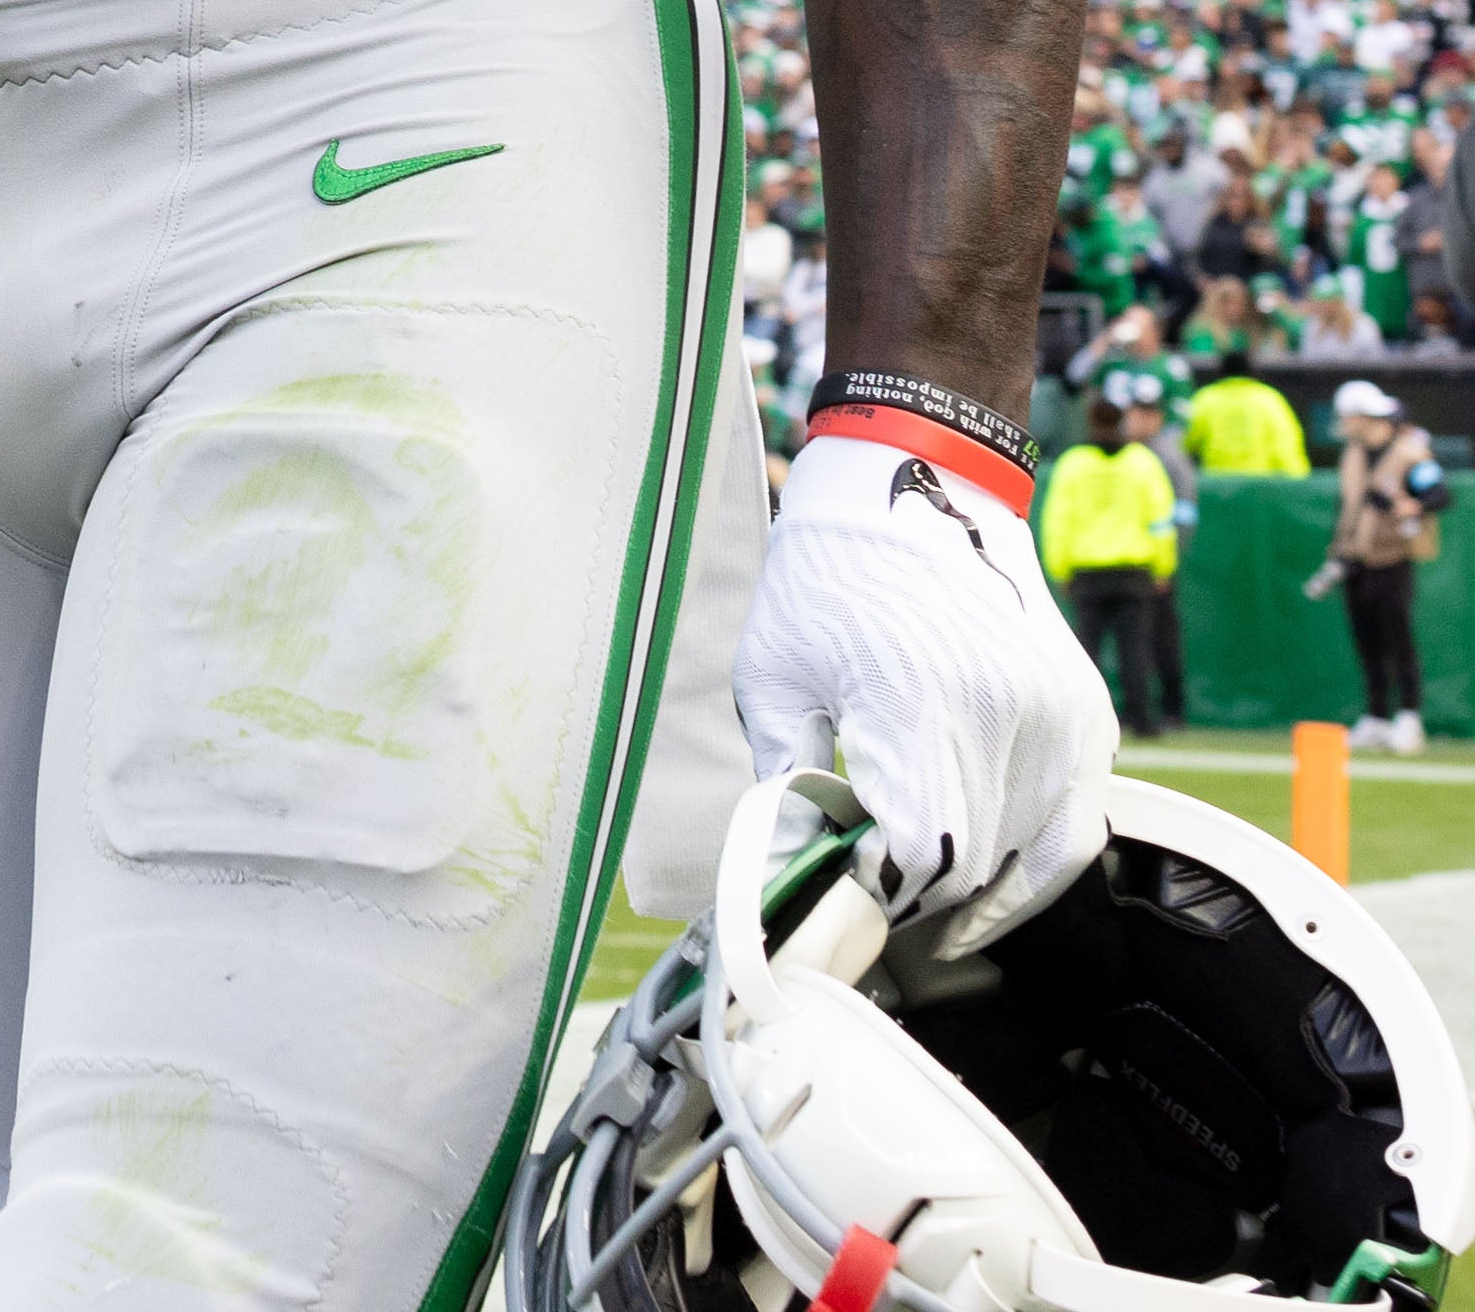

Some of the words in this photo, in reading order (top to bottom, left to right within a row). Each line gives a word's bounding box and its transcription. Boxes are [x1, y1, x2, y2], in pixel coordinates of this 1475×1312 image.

[845, 382, 914, 404] nothing
[959, 399, 980, 418] be
[958, 414, 993, 439] with
[982, 415, 1022, 442] shall
[1120, 1060, 1241, 1172] SPEEDFLEX
